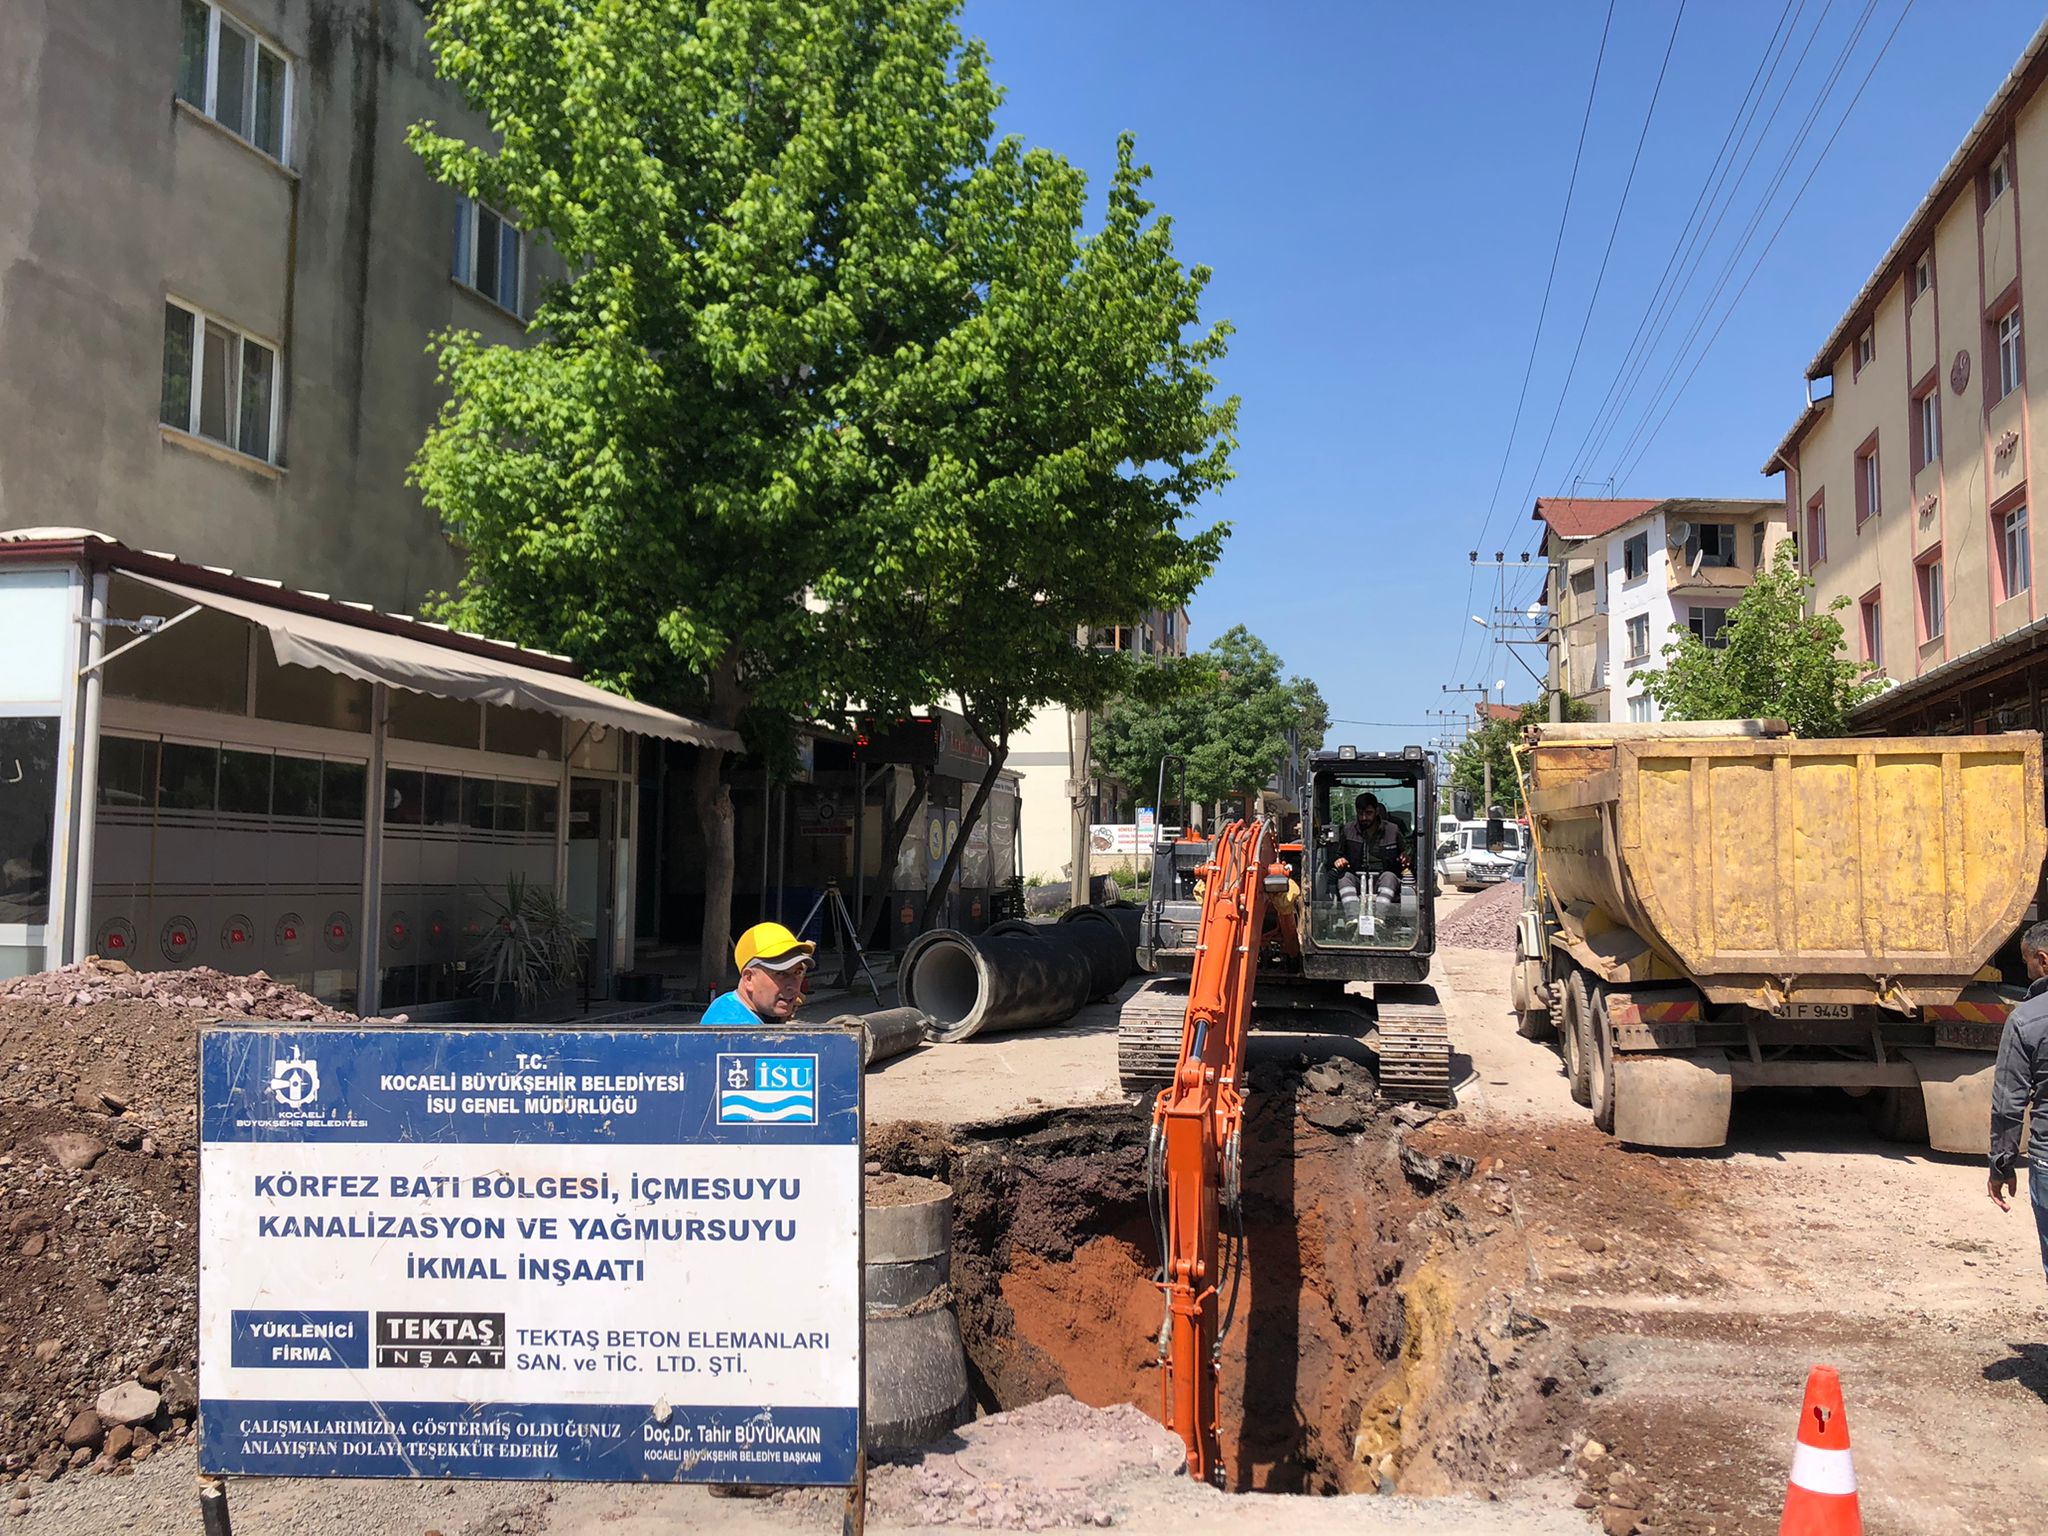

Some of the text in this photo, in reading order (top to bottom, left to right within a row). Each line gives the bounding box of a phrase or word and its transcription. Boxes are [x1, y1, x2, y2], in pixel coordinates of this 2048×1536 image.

[1798, 1005, 1808, 1018] F
[1814, 1005, 1848, 1018] 9449
[516, 1053, 547, 1070] T.C.
[381, 1072, 685, 1095] KOCAELİ BÜYÜKŞEHİR BELEDİYESİ
[758, 1061, 812, 1089] İSU
[278, 1111, 325, 1119] KOCAELİ
[427, 1096, 638, 1115] İSU GENEL MÜDÜRLÜĞÜ
[236, 1119, 368, 1128] BÜYÜKŞEHİR BELEDİYESİ
[254, 1171, 800, 1205] KÖRFEZ BATI BÖLGESİ, İÇMESUYU
[258, 1211, 796, 1241] KANALİZASYON VE YAĞMURSUYU
[407, 1252, 644, 1286] İKMAL İNŞAATI
[250, 1321, 354, 1338] YÜKLENİCİ
[386, 1319, 494, 1346] TEKTAŞ
[516, 1329, 830, 1350] TEKTAŞ BETON ELEMANLARI
[272, 1347, 332, 1361] FİRMA
[378, 1346, 503, 1367] İNŞAAT
[517, 1353, 748, 1377] SAN. ve TİC. LTD. ŞTİ.
[412, 1418, 511, 1440] GÖSTERMİŞ
[518, 1420, 621, 1437] OLDUĞUNUZ
[643, 1424, 821, 1446] Doç.Dr. Tahir BÜYÜKAKIN
[241, 1440, 559, 1460] ANLAYIŞTAN DOLAYI TEŞEKKÜR EDERİZ
[644, 1450, 681, 1461] KOCAELİ
[740, 1450, 780, 1463] BELEDİYE
[783, 1452, 821, 1465] BAŞKANI
